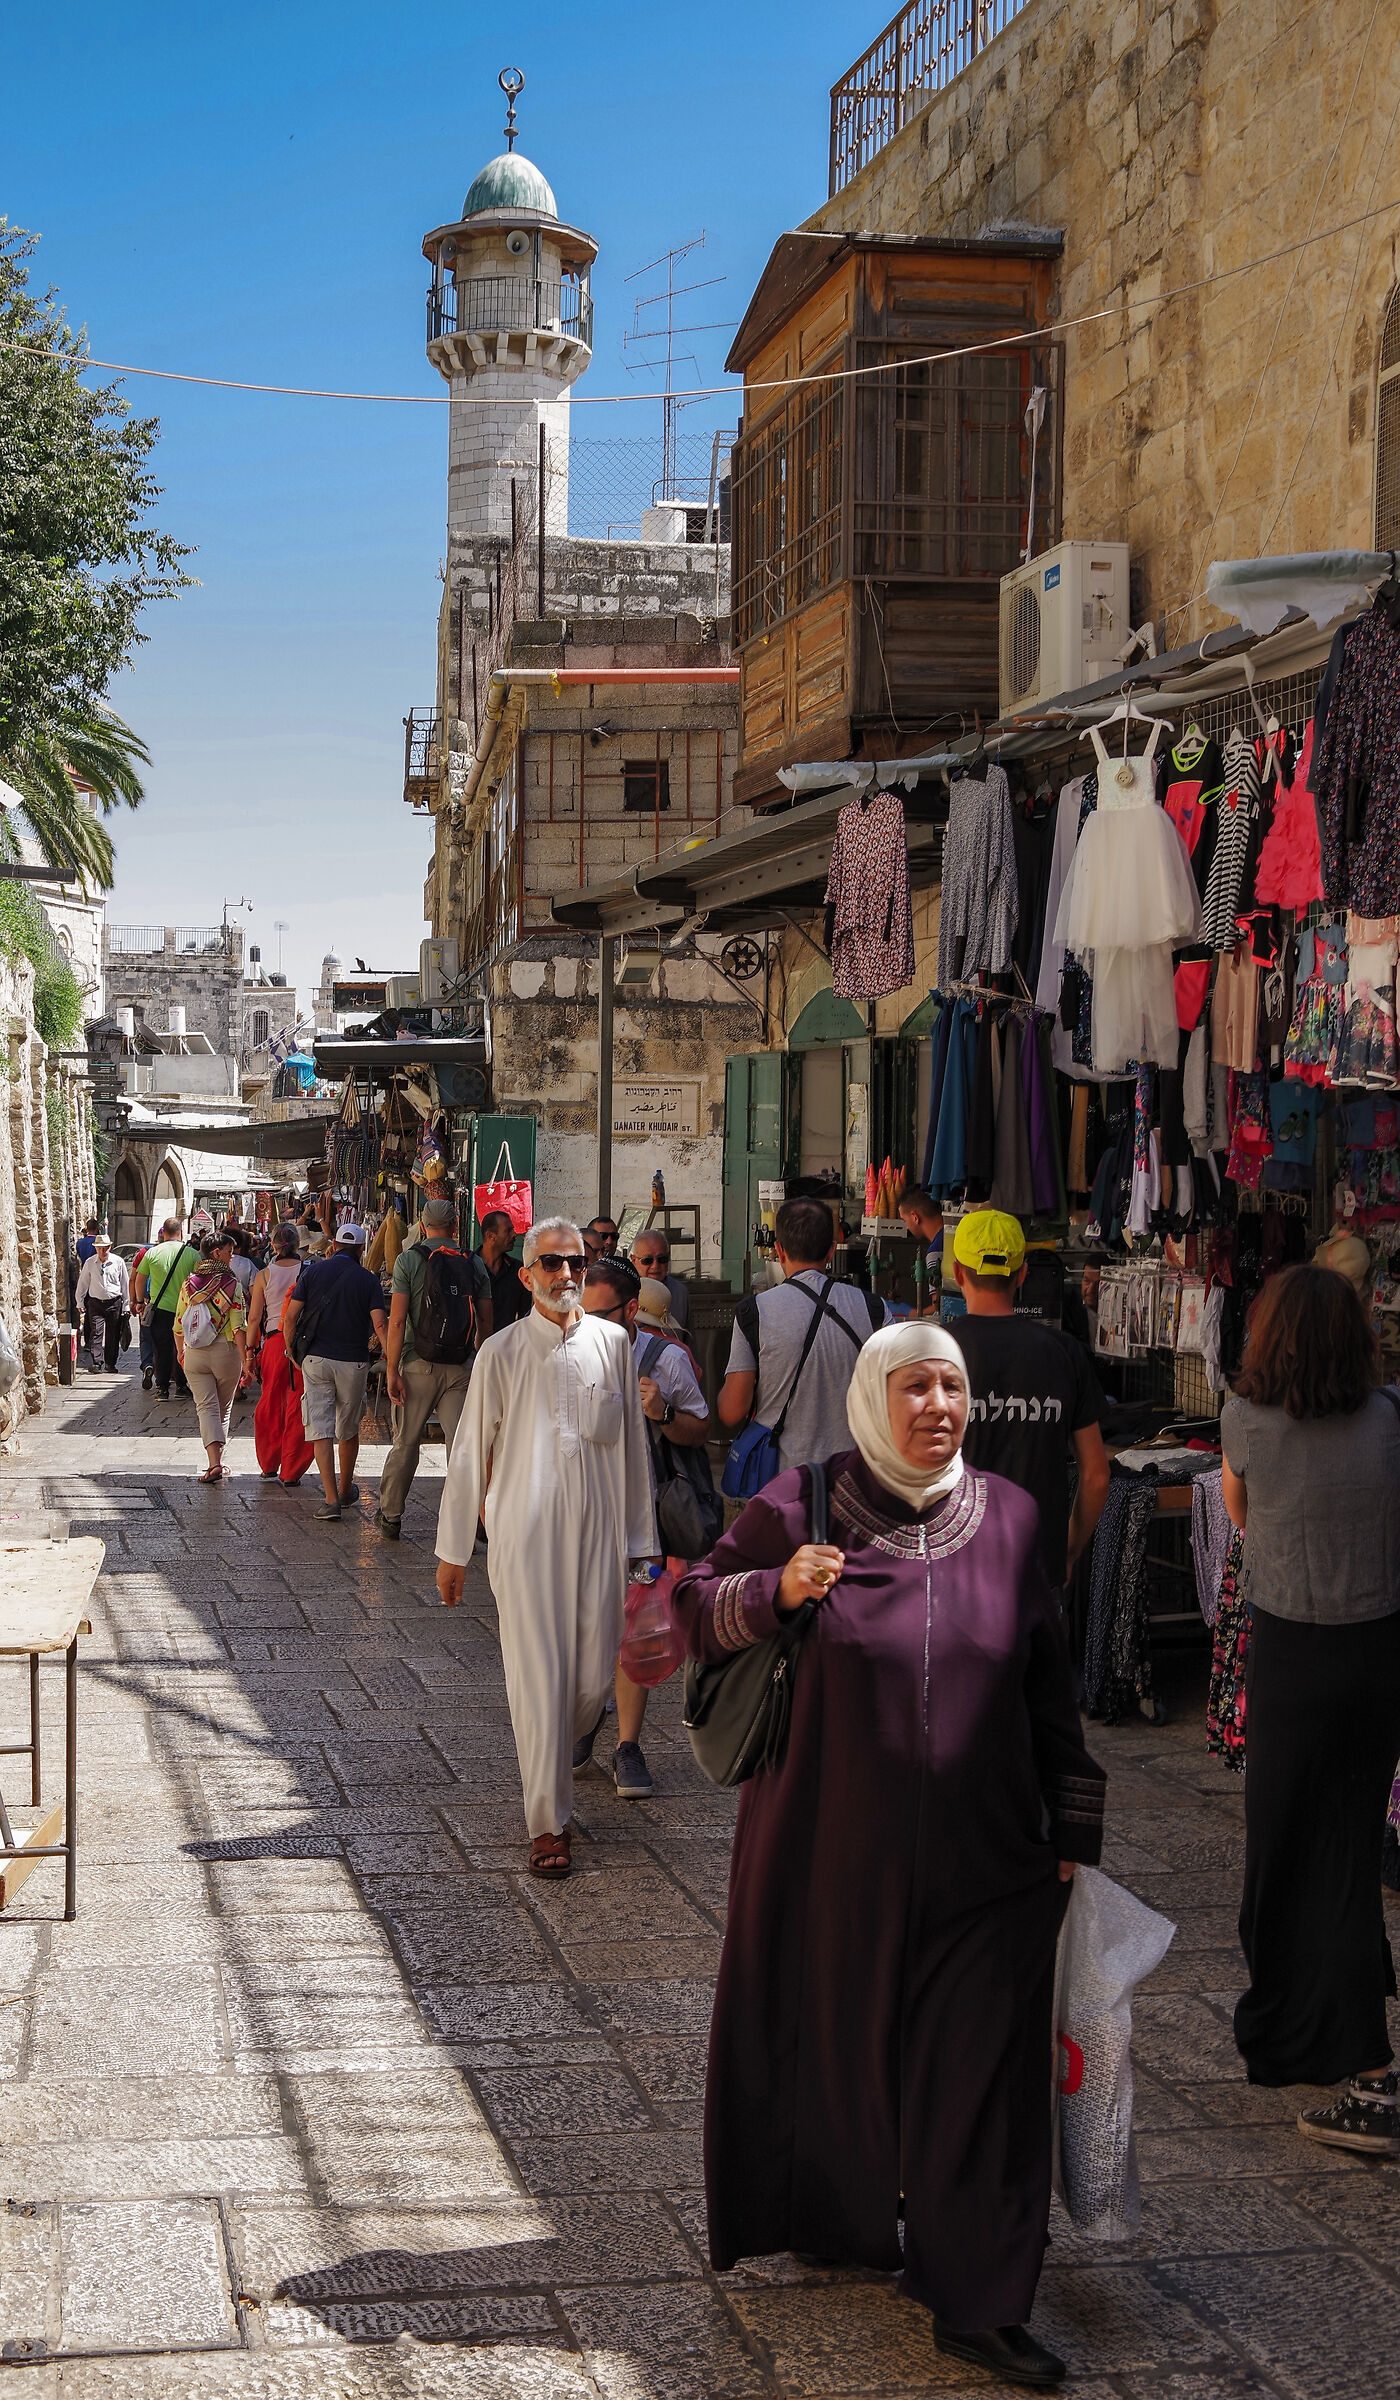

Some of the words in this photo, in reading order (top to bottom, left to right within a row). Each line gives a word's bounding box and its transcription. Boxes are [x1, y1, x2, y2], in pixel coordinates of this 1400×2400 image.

[663, 1088, 682, 1096] רחוב
[630, 1101, 654, 1113] خضير
[655, 1101, 677, 1113] قناطر
[648, 1122, 679, 1132] KHUDAIR
[1013, 1306, 1043, 1314] HNO-ICE
